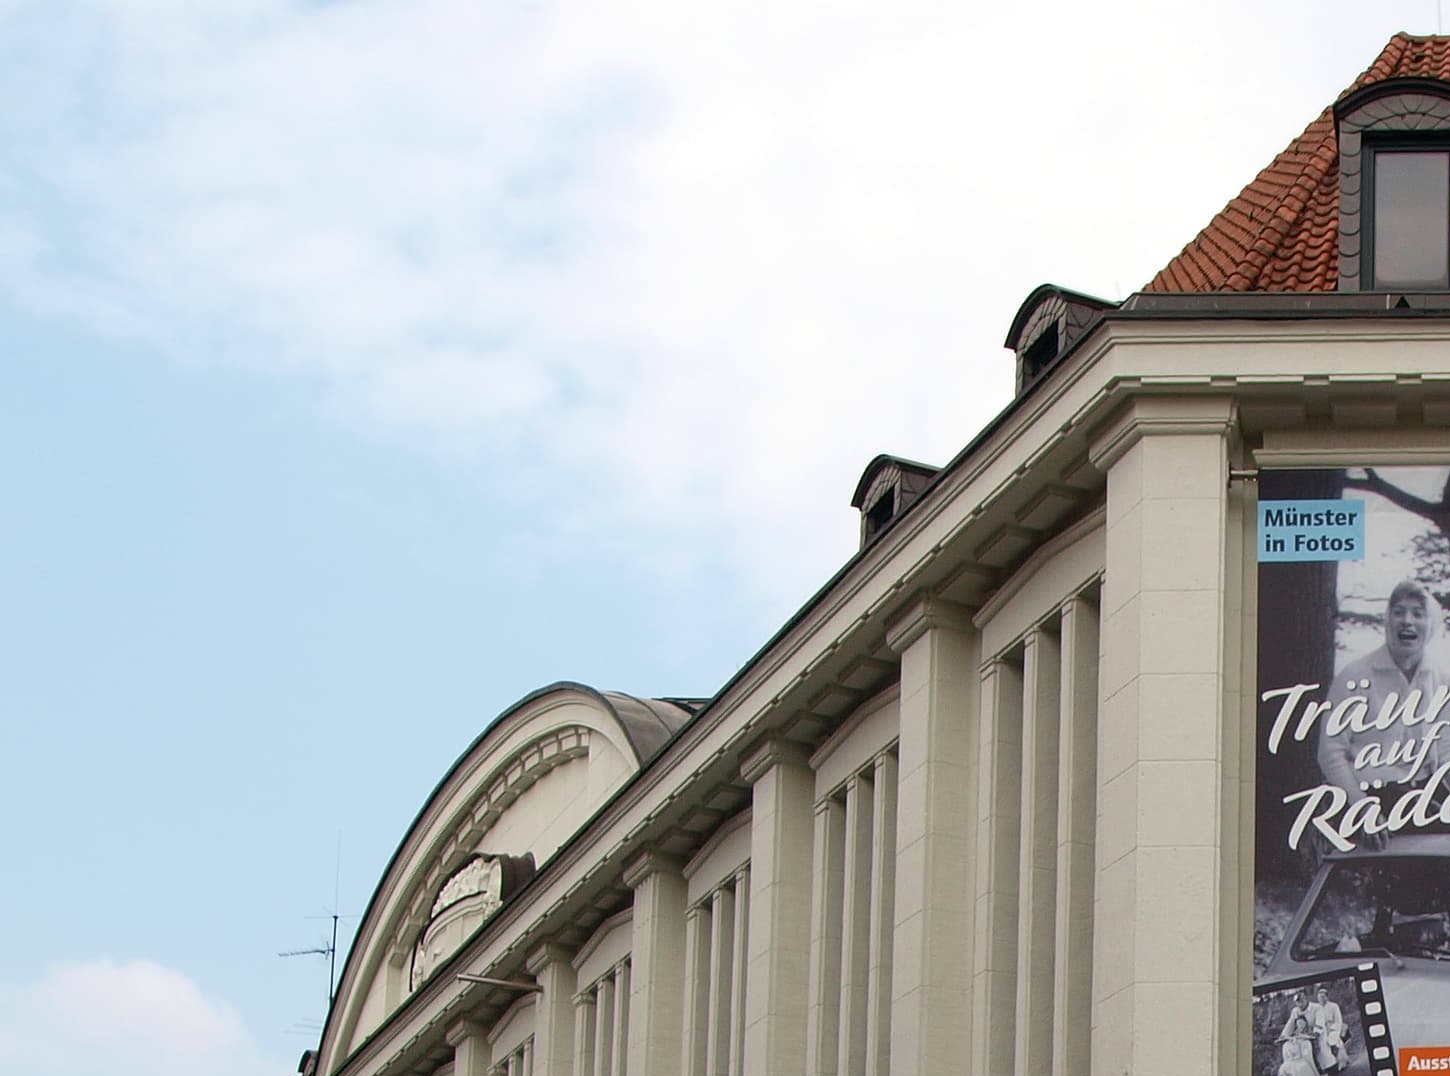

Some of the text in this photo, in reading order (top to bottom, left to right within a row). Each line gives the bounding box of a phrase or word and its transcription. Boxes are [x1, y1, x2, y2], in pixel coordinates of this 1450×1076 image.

[1264, 508, 1358, 527] Münster
[1265, 534, 1355, 552] in Fotos
[1354, 720, 1450, 784] auf
